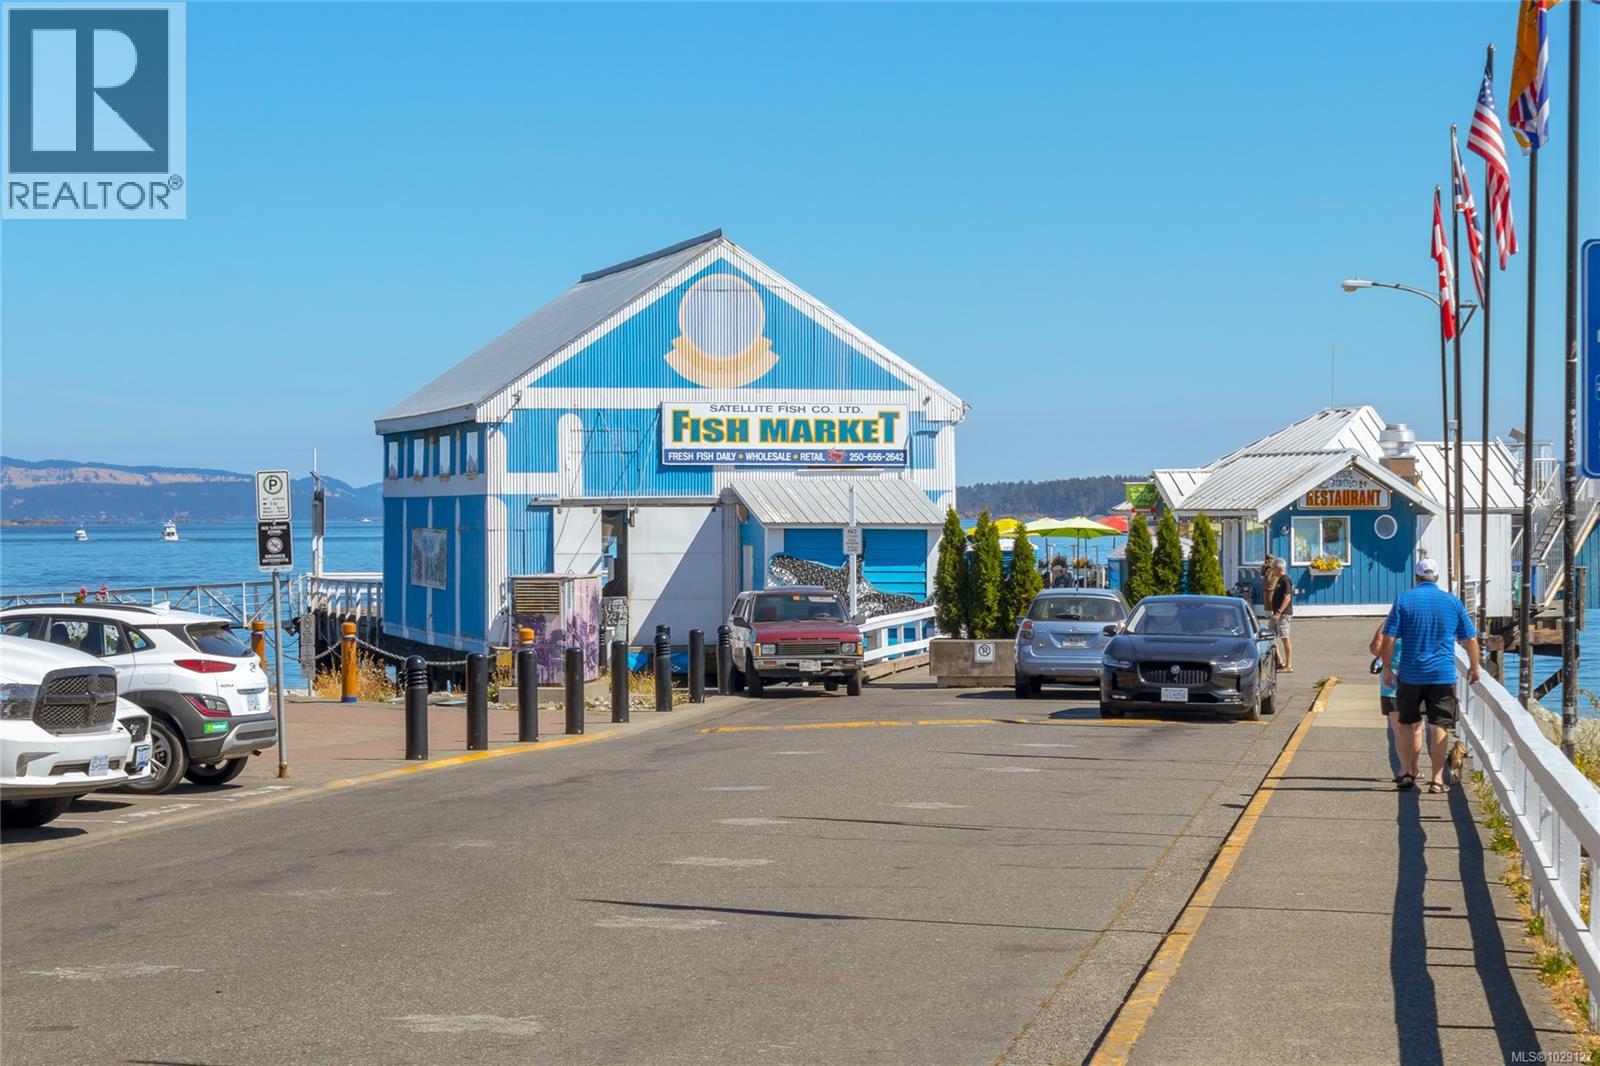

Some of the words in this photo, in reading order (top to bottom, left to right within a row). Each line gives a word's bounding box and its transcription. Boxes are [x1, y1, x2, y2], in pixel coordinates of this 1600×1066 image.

[710, 404, 773, 413] SATELLITE
[778, 405, 806, 413] FISH
[811, 405, 833, 414] CO.
[838, 405, 864, 414] LTD.
[758, 410, 901, 444] MARKET
[668, 452, 694, 461] FRESH
[696, 452, 714, 461] FISH
[716, 452, 737, 461] DAILY
[745, 452, 792, 461] WHOLESALE
[800, 452, 825, 461] RETAIL
[849, 452, 904, 462] 250-656-2642
[1305, 489, 1382, 506] RESTAURANT
